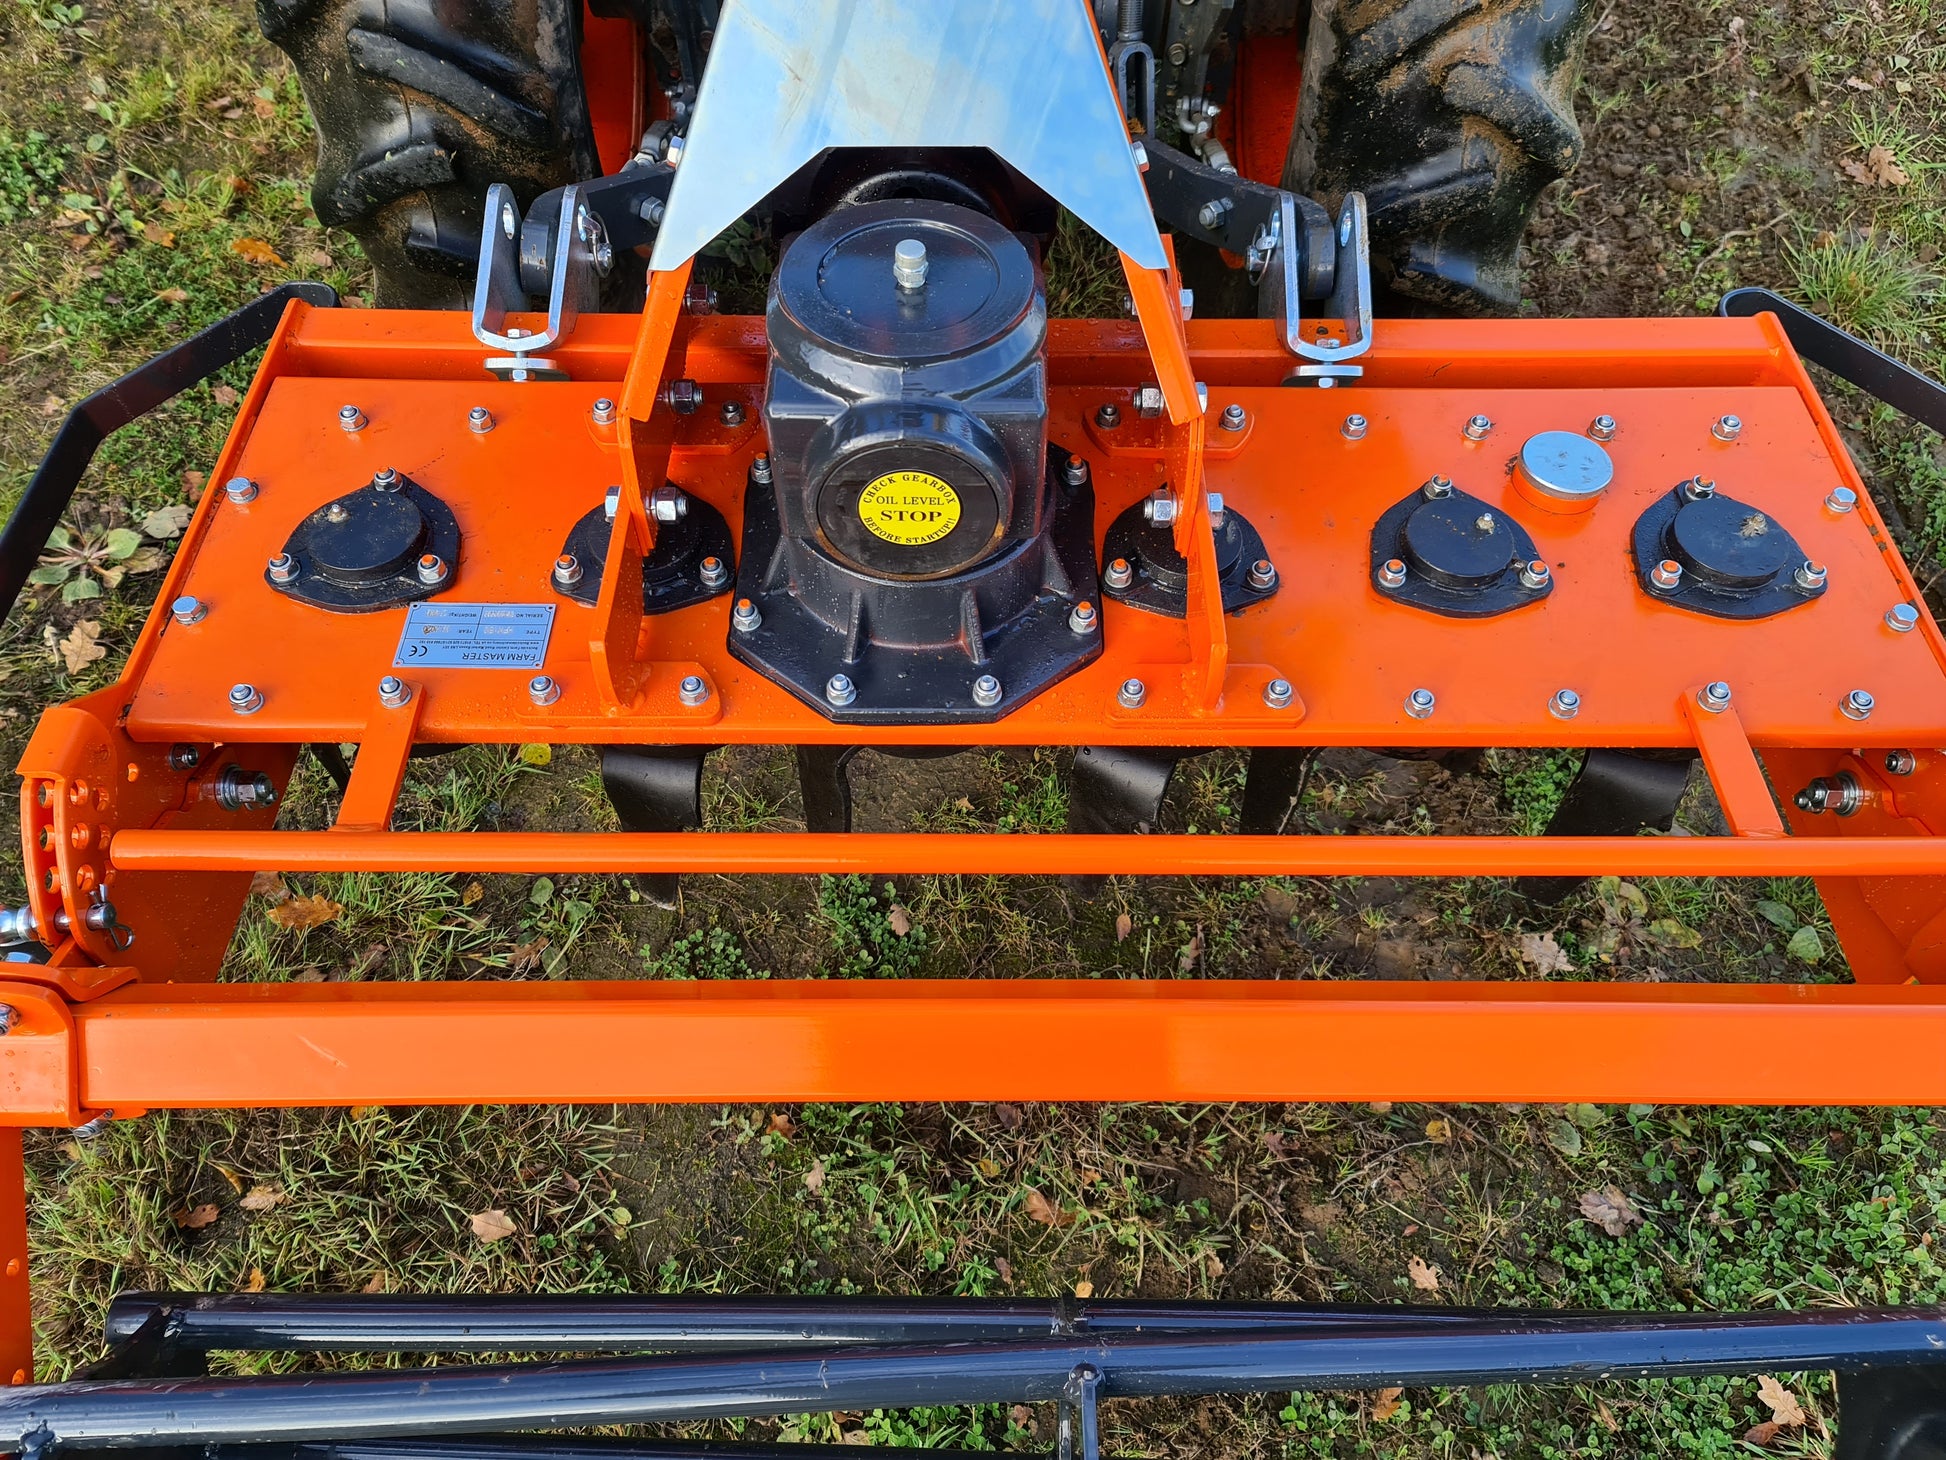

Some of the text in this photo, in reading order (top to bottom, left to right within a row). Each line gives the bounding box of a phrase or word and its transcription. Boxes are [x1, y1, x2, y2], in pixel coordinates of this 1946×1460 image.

[863, 474, 956, 504] CHECK GEARBOX
[876, 496, 945, 506] OIL LEVEL
[880, 510, 942, 522] STOP
[863, 516, 902, 543] BEFORE
[462, 652, 536, 661] FARM MASTER
